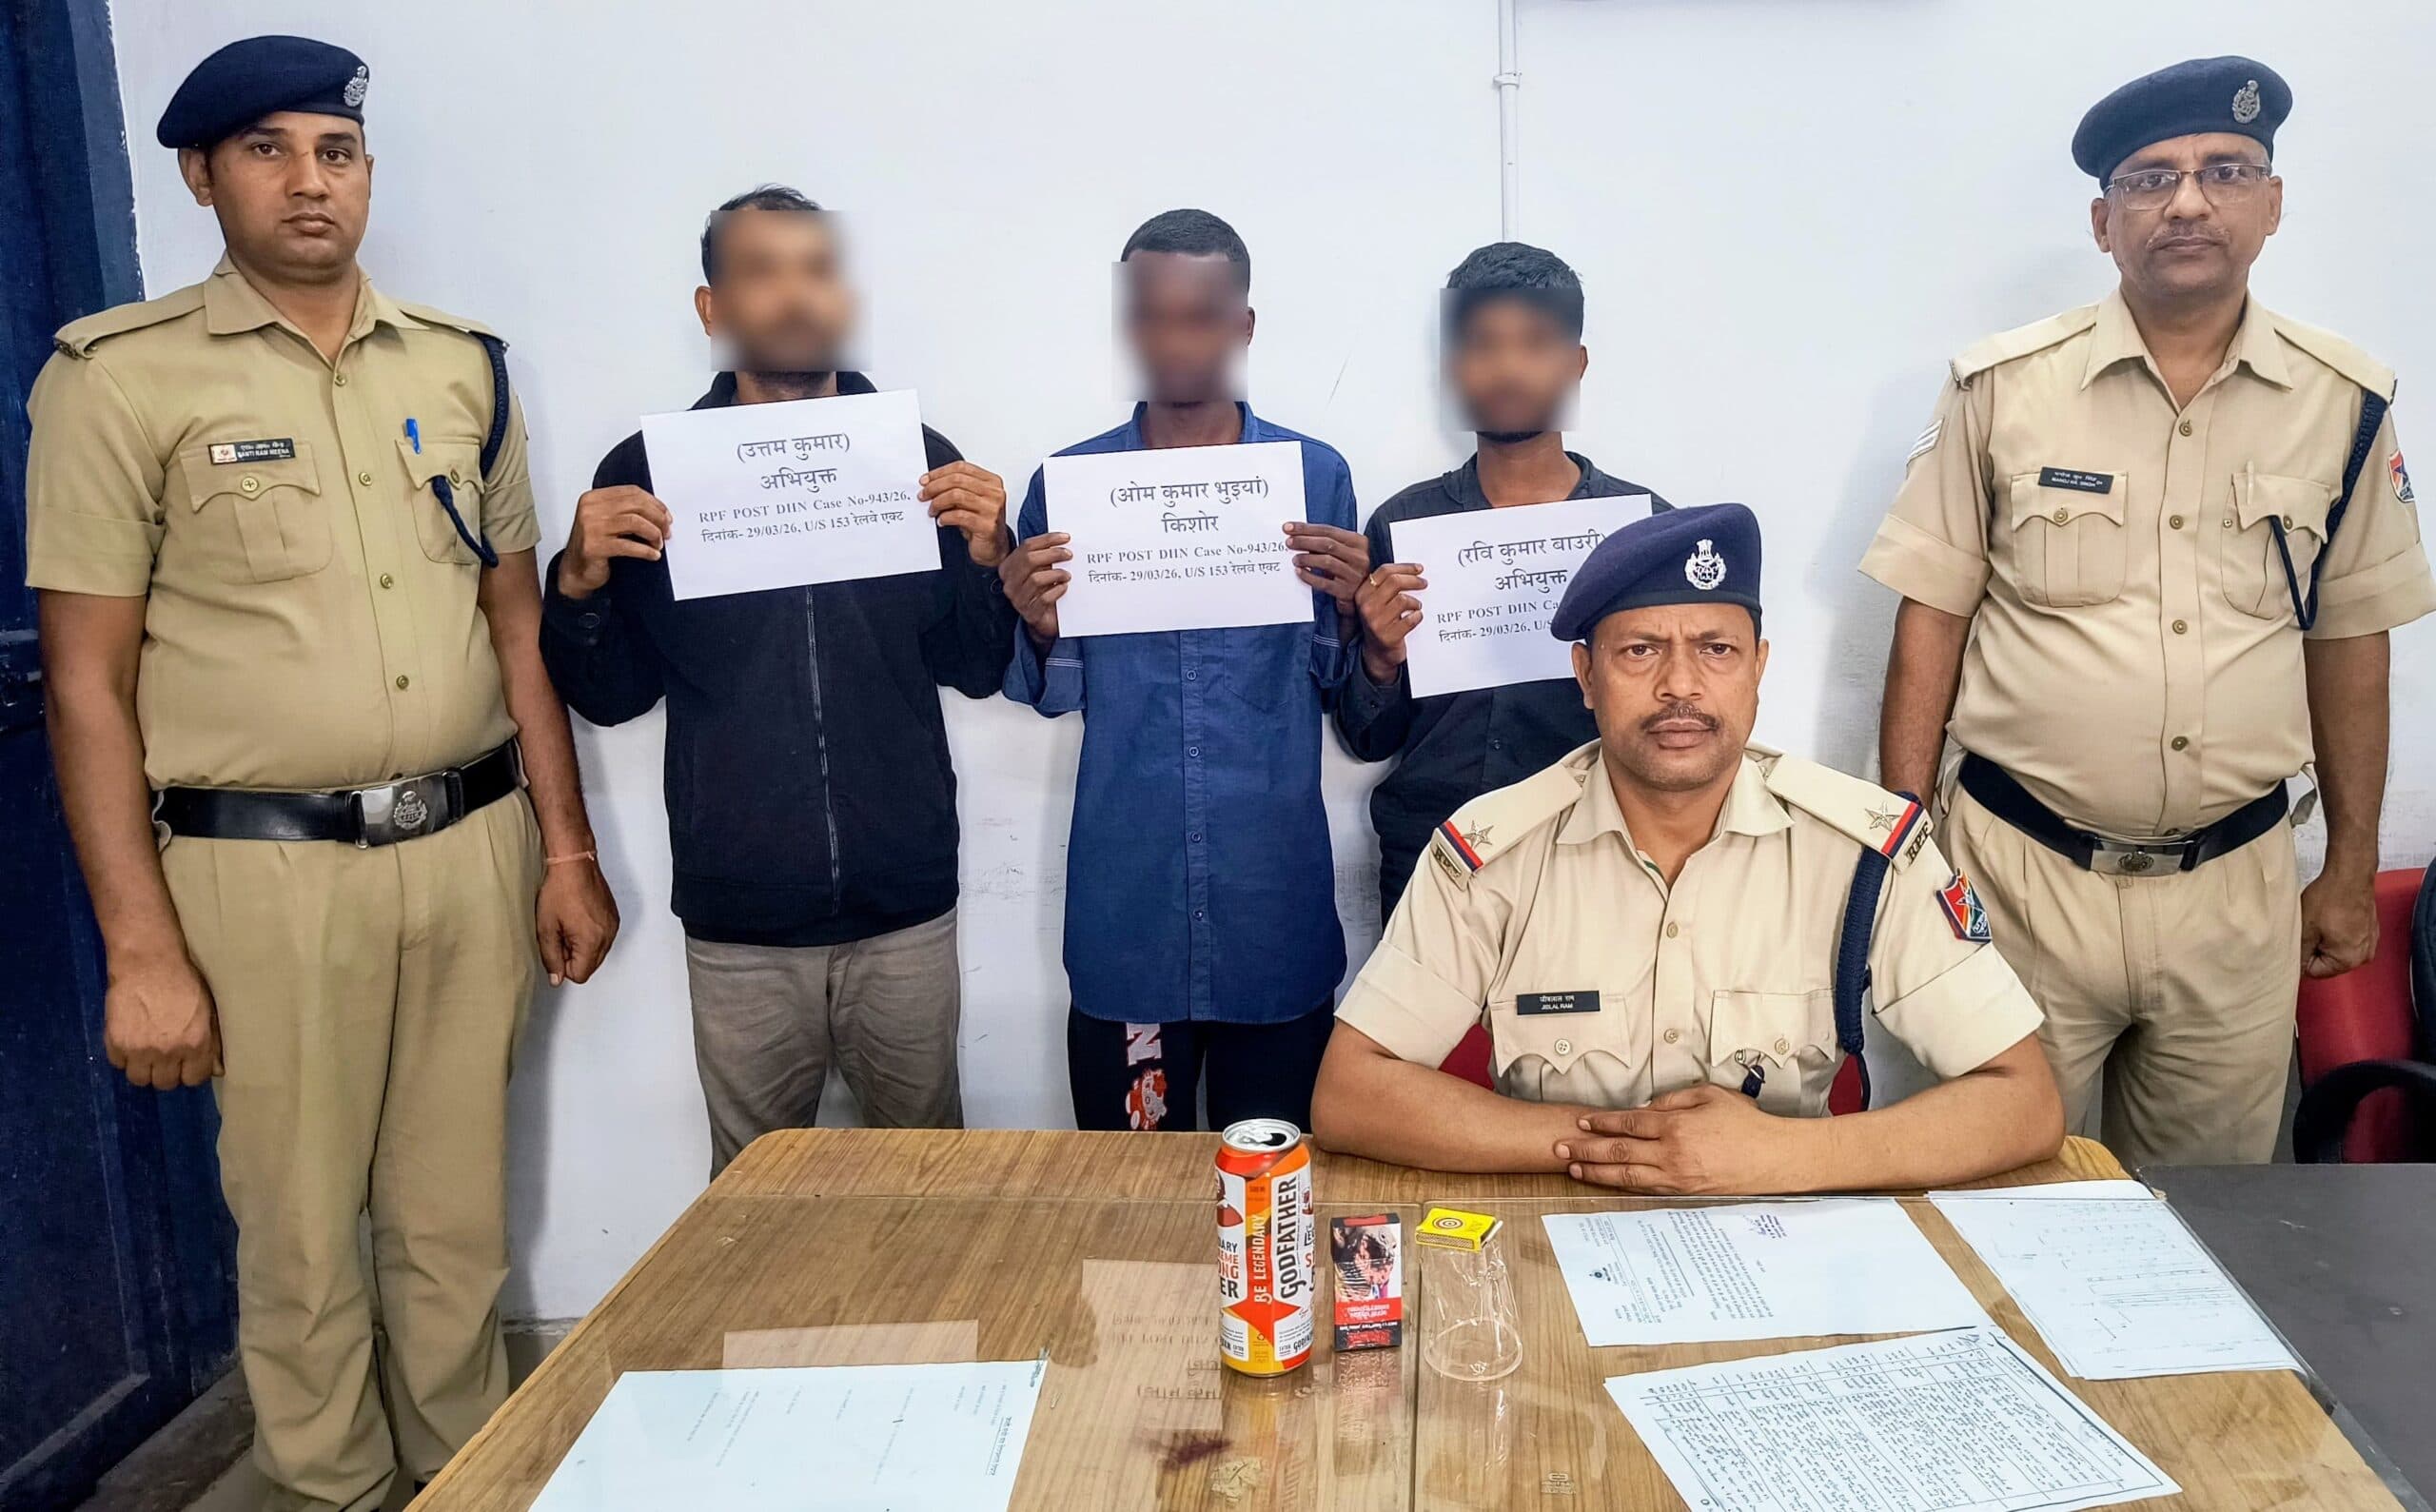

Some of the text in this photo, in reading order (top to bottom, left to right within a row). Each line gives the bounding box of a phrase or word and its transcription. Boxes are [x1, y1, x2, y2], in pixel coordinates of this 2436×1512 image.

[737, 433, 850, 462] (उत्तम कुमार)
[761, 467, 837, 493] अभियुक्त
[1110, 481, 1155, 507] (ओम
[1161, 482, 1208, 507] कुमार
[699, 510, 726, 523] RPF
[733, 505, 769, 520] POST
[776, 502, 807, 515] DHN
[814, 499, 842, 511] Case
[804, 520, 826, 532] U/S
[831, 516, 850, 530] 153
[850, 511, 877, 526] रेलवे
[1161, 510, 1219, 533] किशोर
[1087, 553, 1112, 563] RPF
[1119, 550, 1153, 562] POST
[1159, 548, 1188, 560] DHN
[1194, 546, 1222, 557] Case
[1458, 540, 1493, 567] (रवि
[1498, 540, 1546, 565] कुमार
[1186, 566, 1205, 579] U/S
[1210, 565, 1228, 577] 153
[1229, 560, 1255, 575] रेलवे
[1495, 568, 1567, 594] अभियुक्त
[1437, 599, 1560, 624] RPF POST DHN Ca
[1534, 619, 1552, 632] U/S
[1252, 1214, 1267, 1280] LEGENDARY
[1277, 1176, 1306, 1299] GODFATHER
[1254, 1286, 1272, 1305] BE
